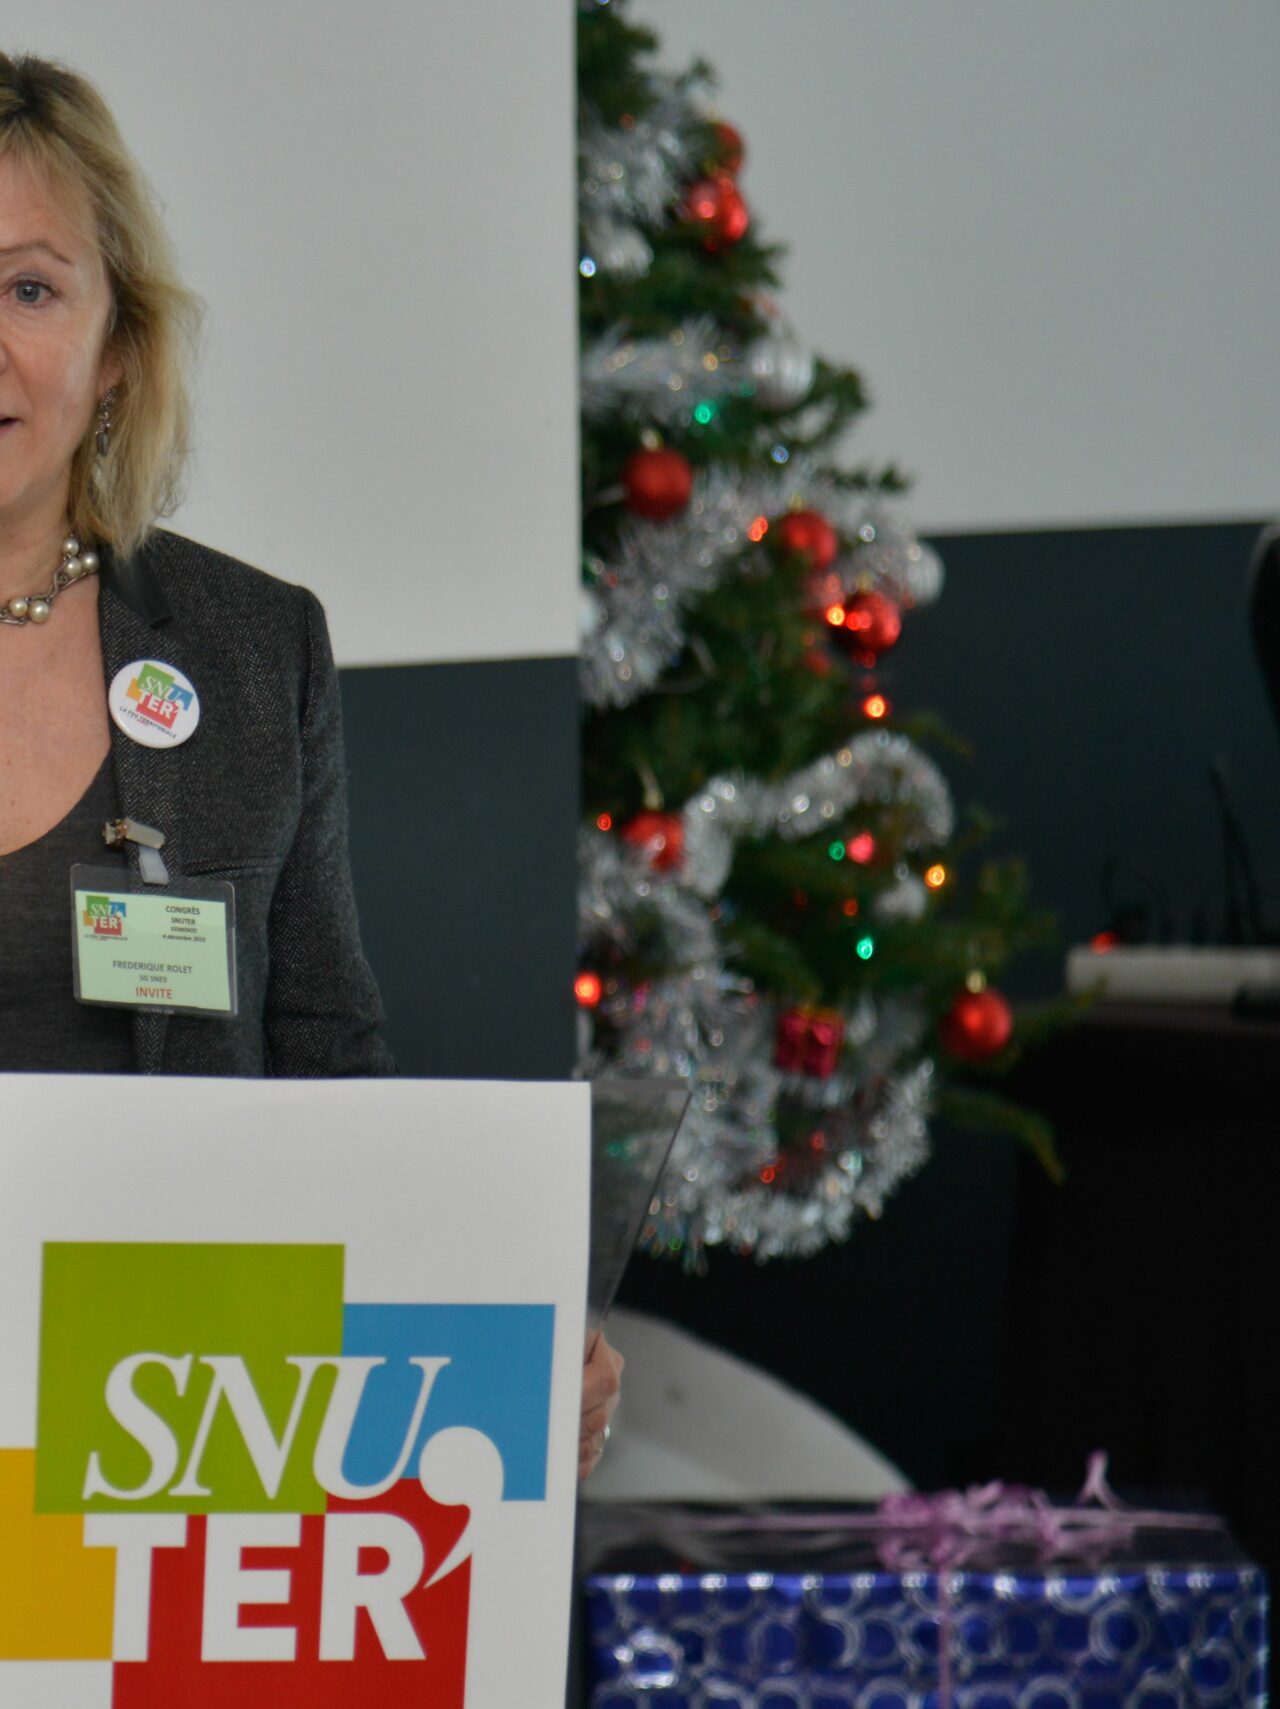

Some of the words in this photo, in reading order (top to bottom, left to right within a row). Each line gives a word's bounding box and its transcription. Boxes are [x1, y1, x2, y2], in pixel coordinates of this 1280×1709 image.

[165, 905, 200, 915] CONGRÈS
[171, 917, 196, 925] SNUTER
[112, 960, 165, 972] FREDERIQUE
[167, 964, 192, 974] ROLET
[150, 975, 168, 983] SNES
[135, 986, 173, 999] INVITE
[82, 1512, 426, 1662] TER
